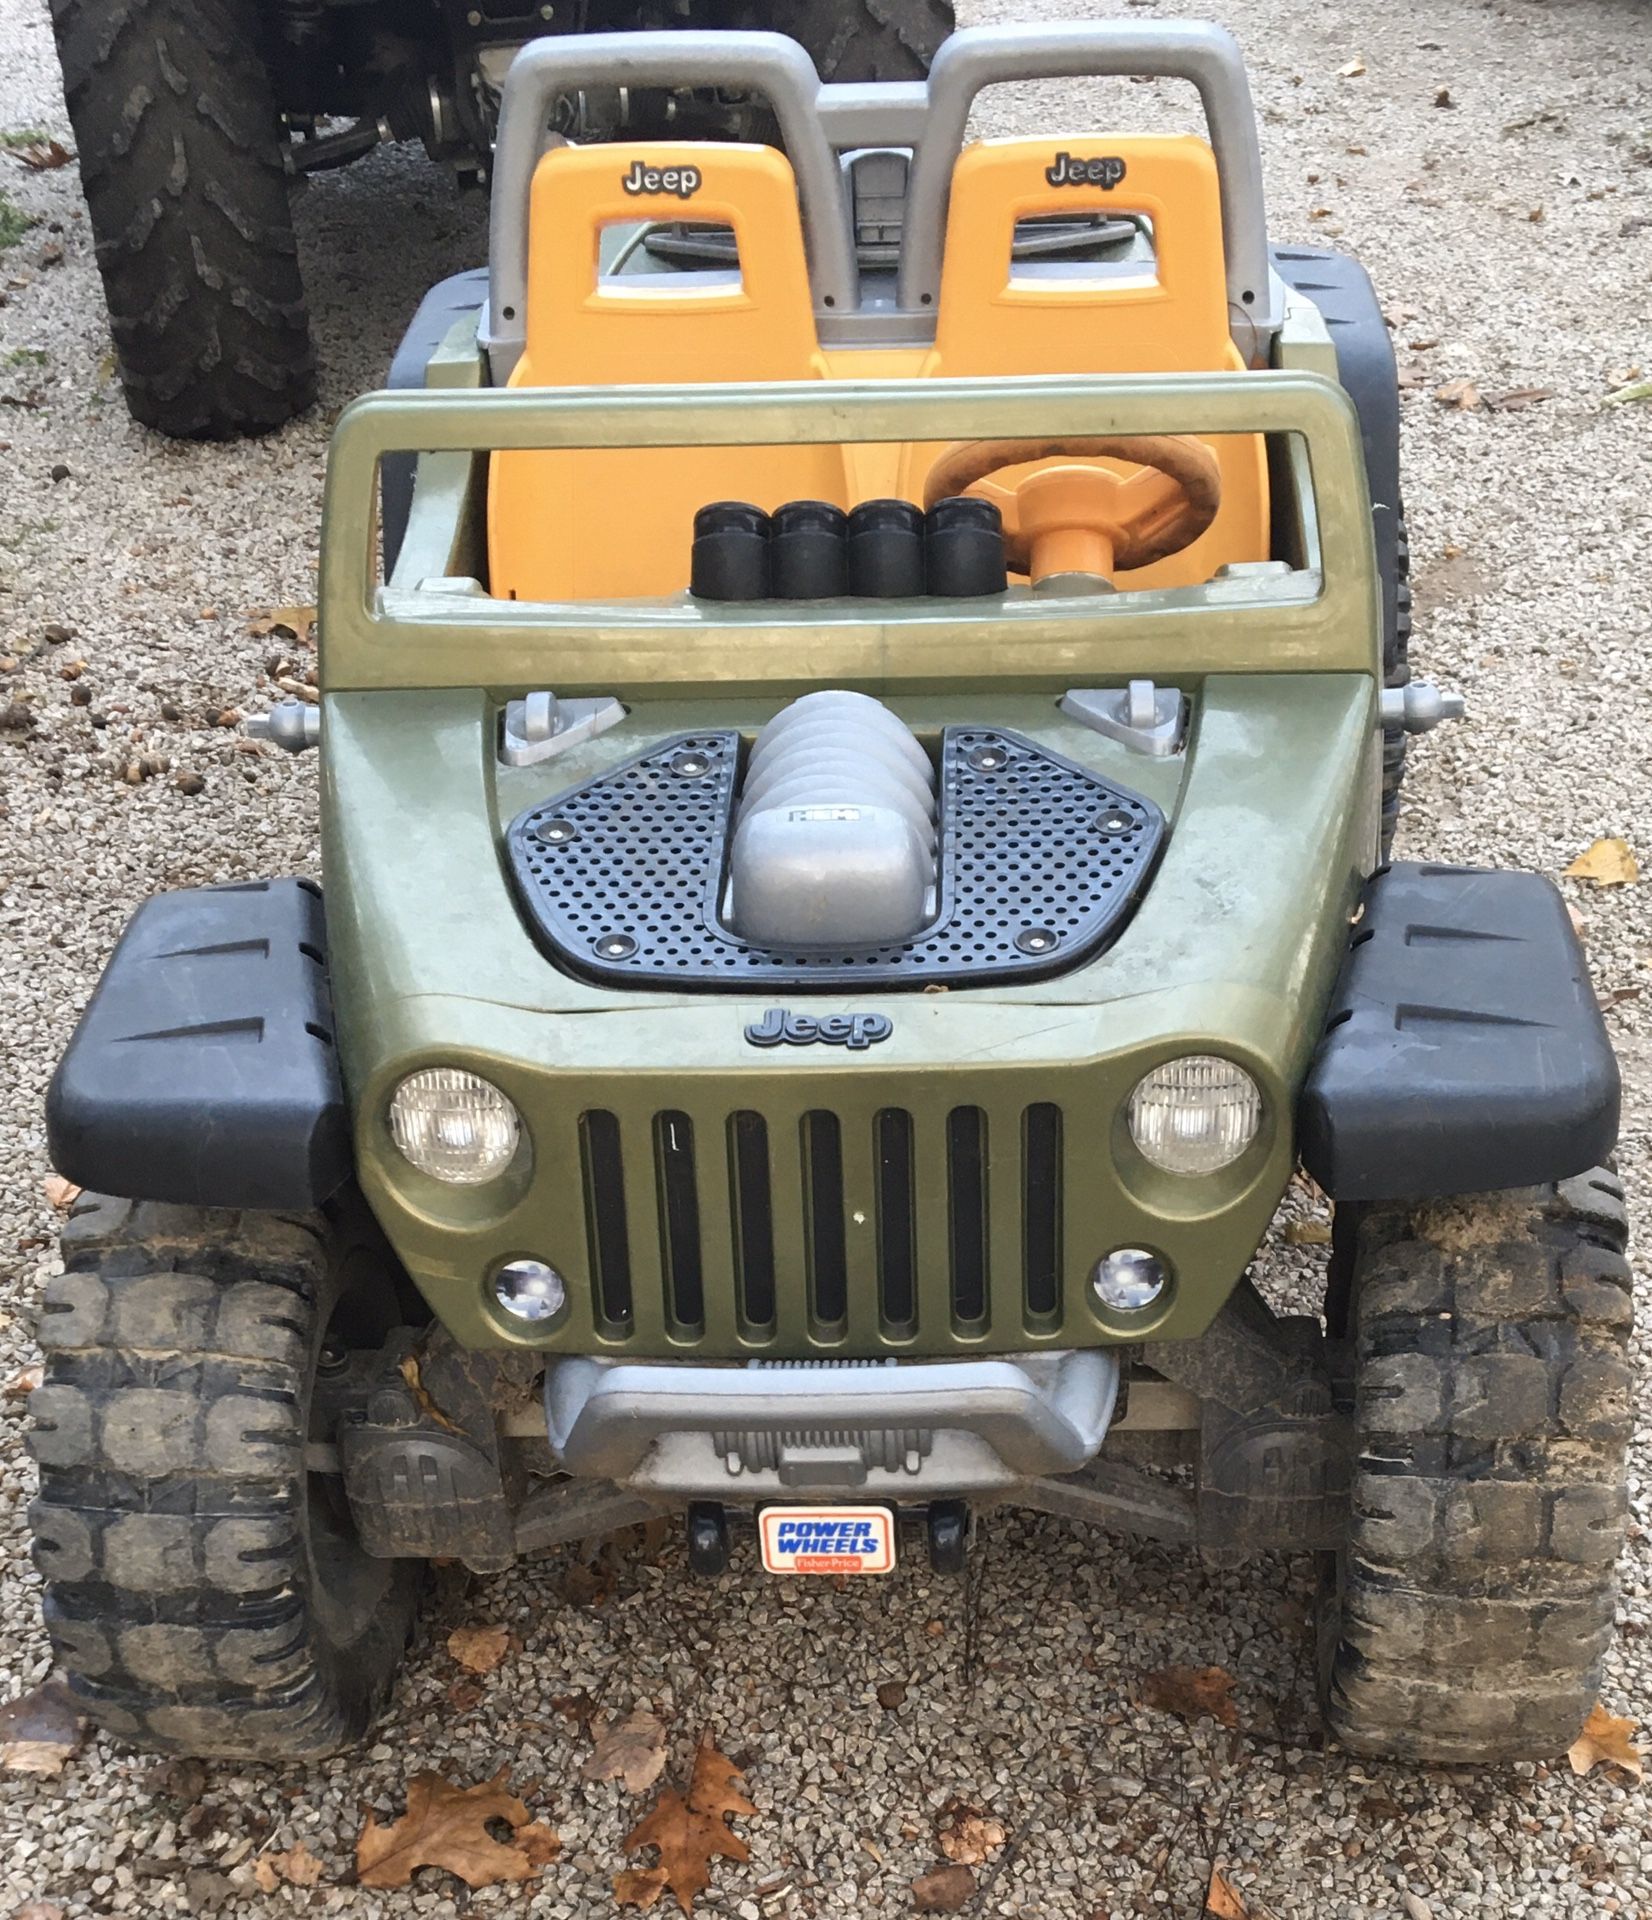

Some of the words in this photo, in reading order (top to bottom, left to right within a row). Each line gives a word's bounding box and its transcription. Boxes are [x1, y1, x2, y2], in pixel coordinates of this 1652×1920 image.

[624, 161, 701, 197] Jeep
[1047, 153, 1125, 188] Jeep
[746, 1008, 892, 1048] Jeep
[777, 1522, 872, 1537] POWER
[777, 1538, 878, 1553] WHEELS
